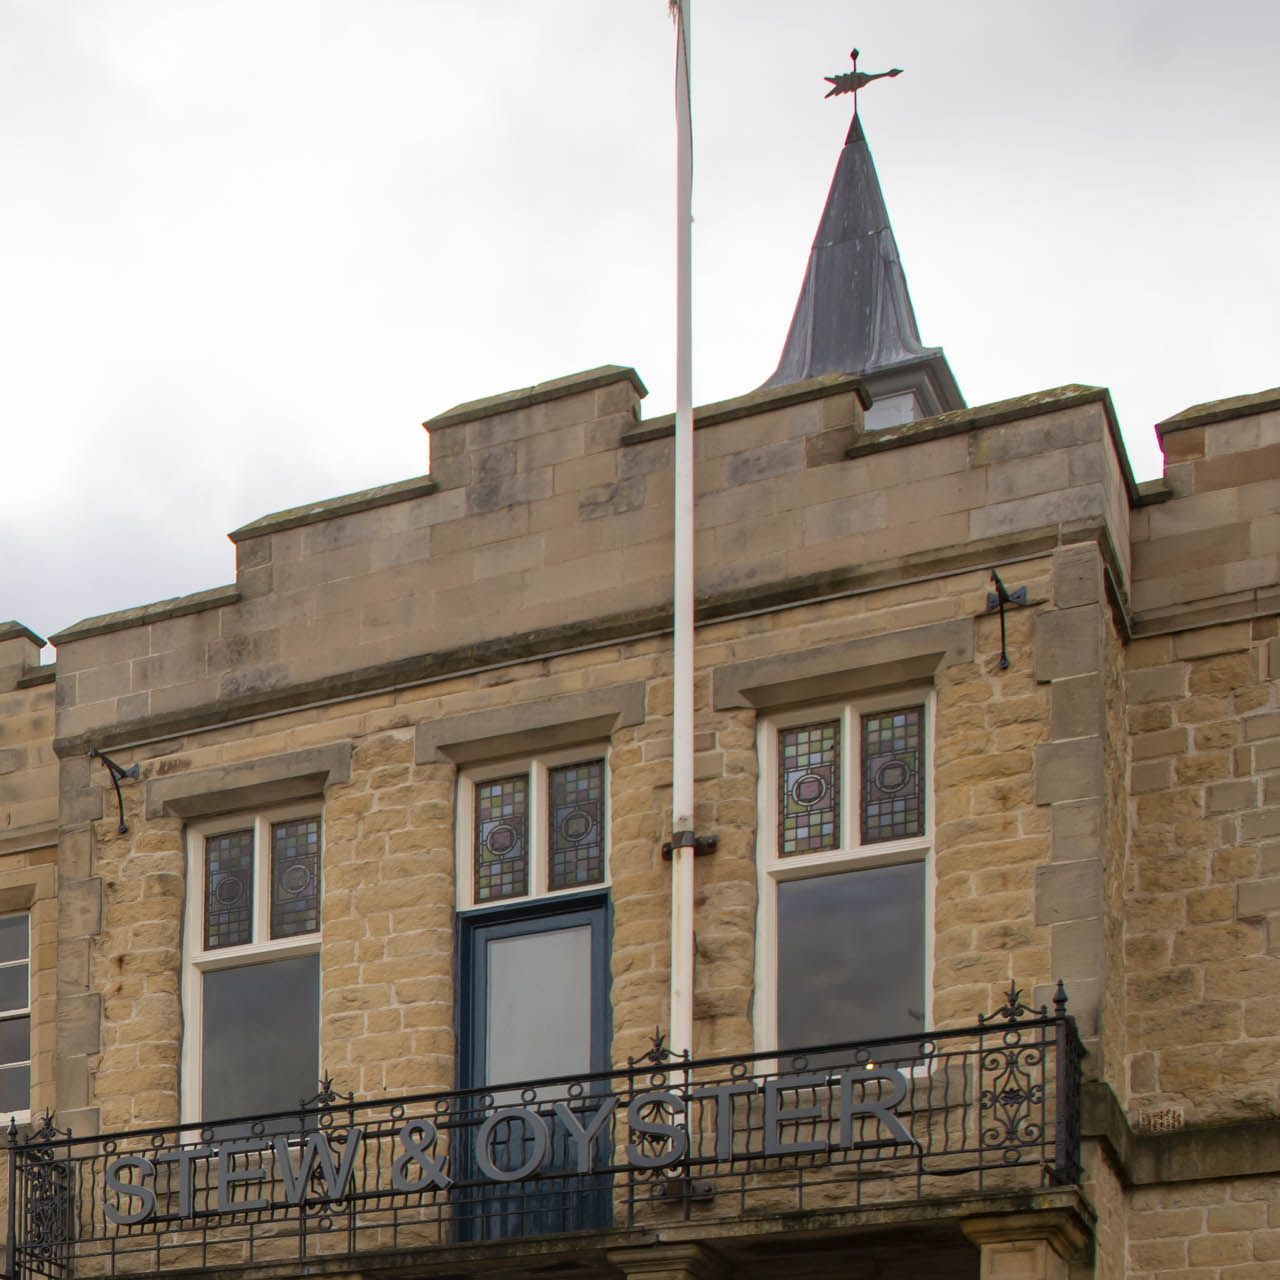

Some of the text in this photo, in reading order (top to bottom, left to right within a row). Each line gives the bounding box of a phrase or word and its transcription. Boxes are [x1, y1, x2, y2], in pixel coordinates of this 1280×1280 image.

[103, 1066, 917, 1225] STEW & OYSTER
